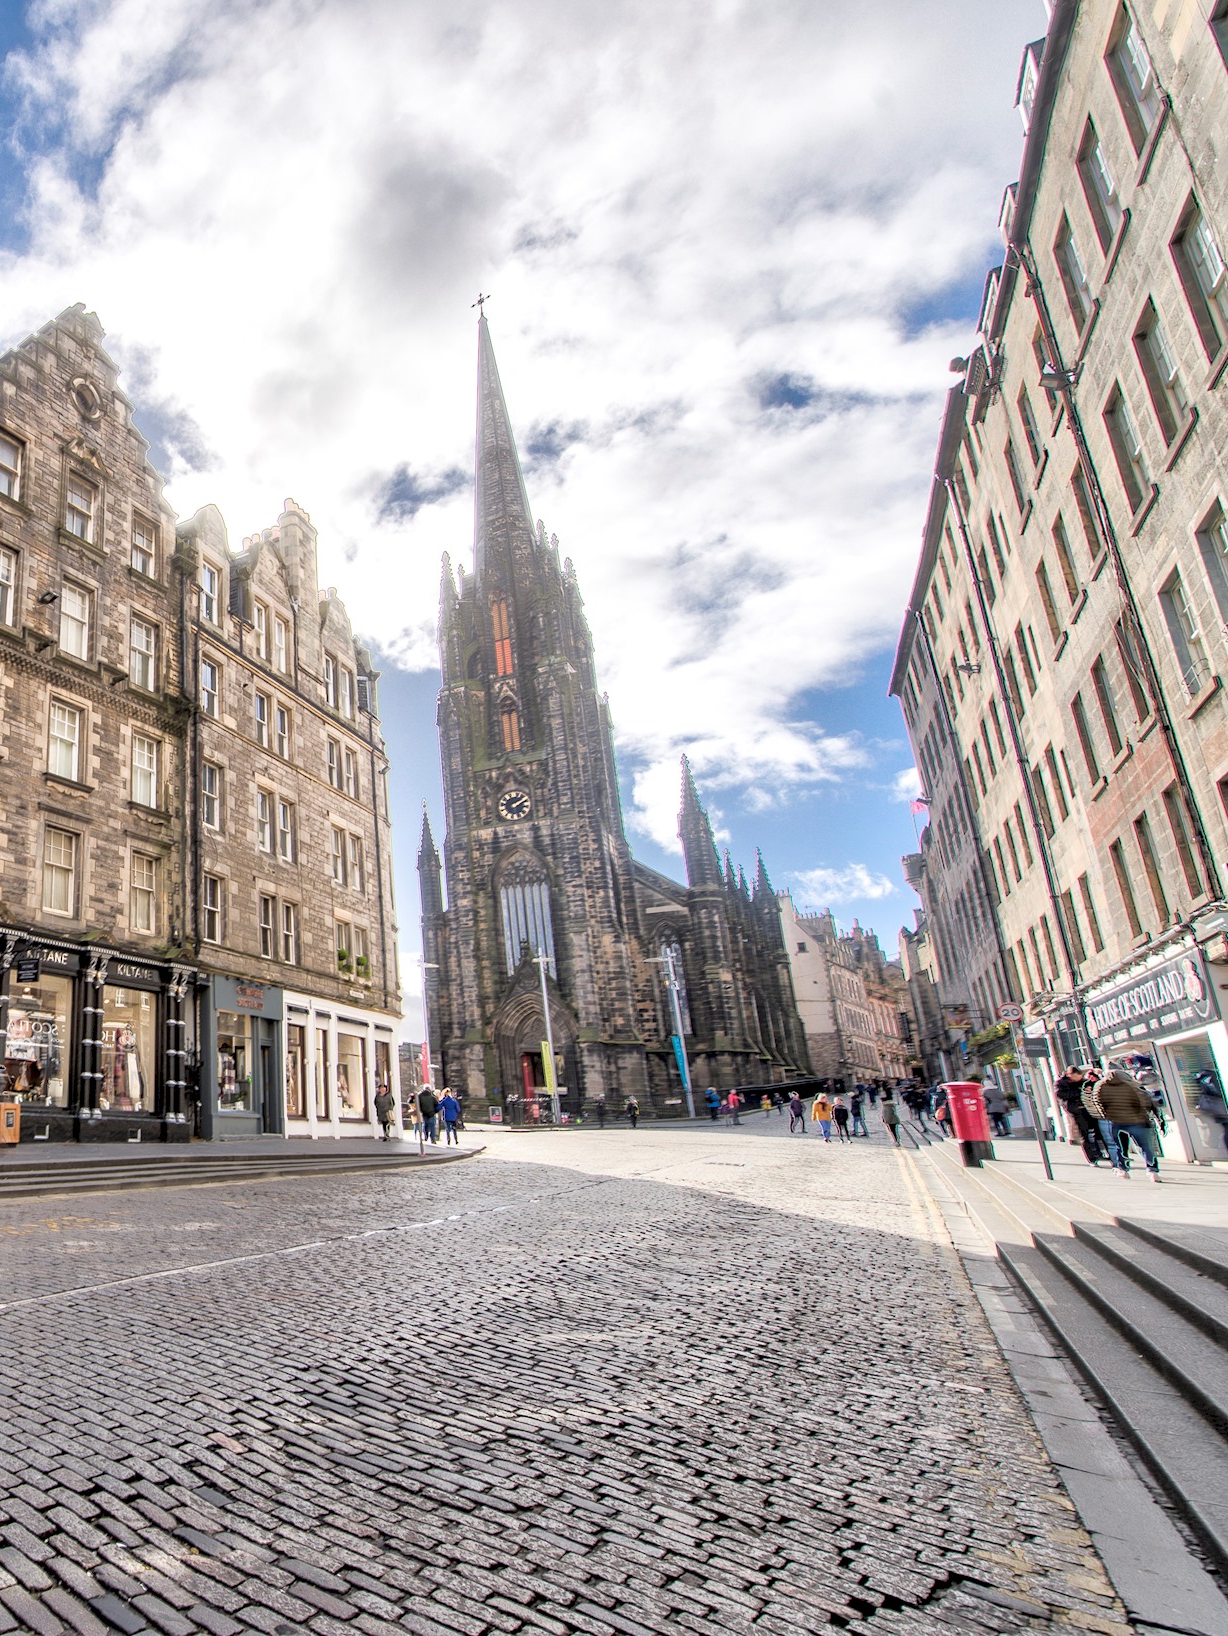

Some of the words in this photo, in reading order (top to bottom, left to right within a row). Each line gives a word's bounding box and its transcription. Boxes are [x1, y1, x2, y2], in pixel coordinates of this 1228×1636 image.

[117, 963, 153, 980] KILTANE
[1093, 998, 1120, 1031] HOUSE
[1118, 992, 1133, 1021] OF
[1129, 970, 1186, 1016] SCOTLAND
[1001, 1008, 1020, 1017] 20
